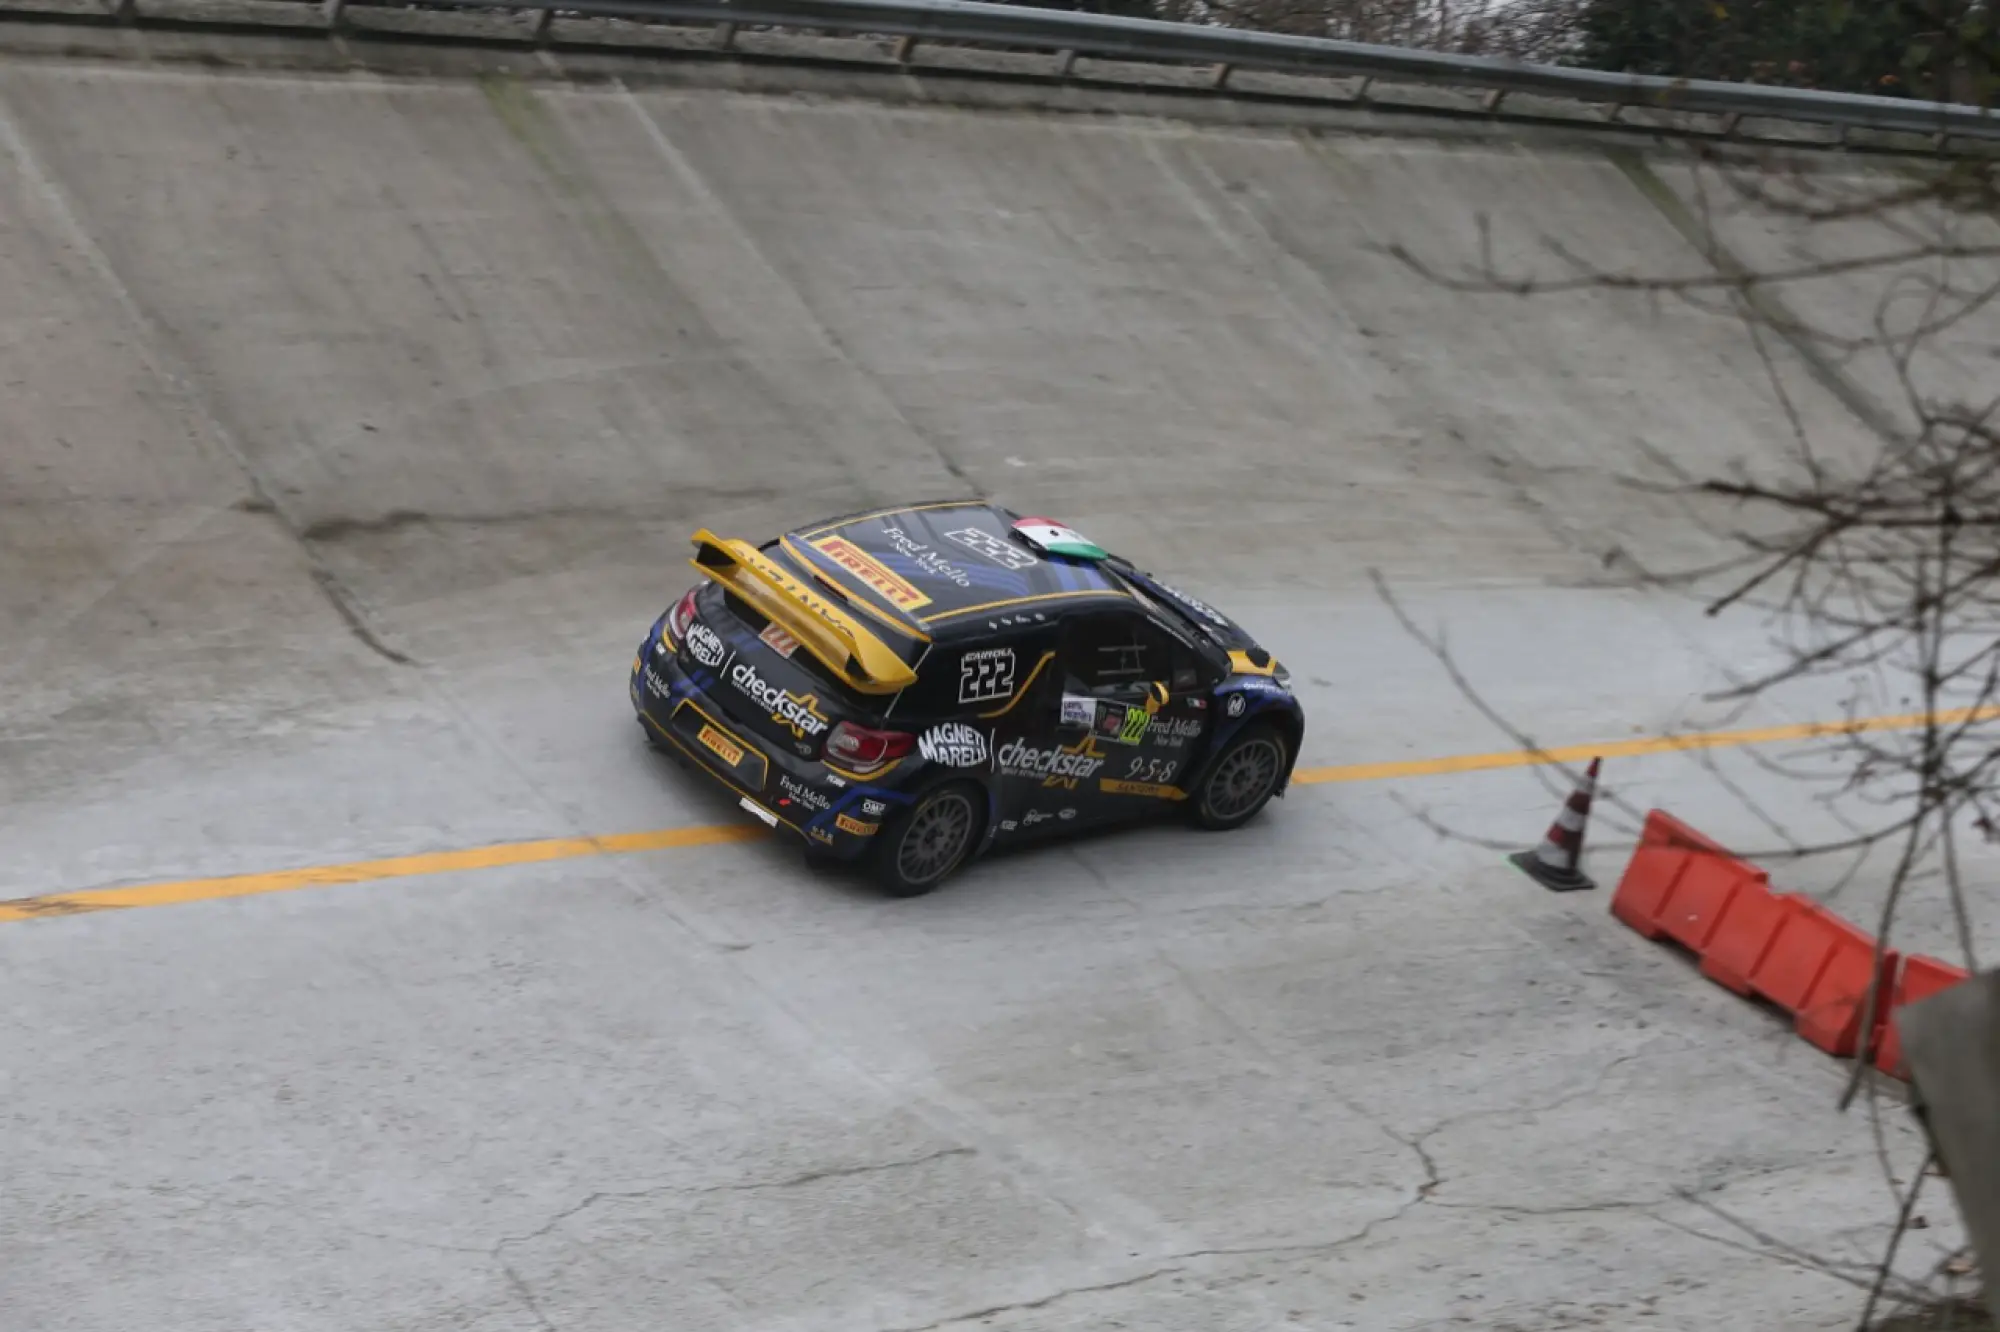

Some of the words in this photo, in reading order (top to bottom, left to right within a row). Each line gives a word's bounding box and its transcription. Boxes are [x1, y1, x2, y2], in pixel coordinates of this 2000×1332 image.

[819, 540, 920, 604] PIRELLI
[958, 652, 1016, 704] 222
[732, 664, 829, 736] checkstar
[918, 722, 985, 750] MAGNETI
[918, 742, 987, 768] MARELLI
[998, 736, 1105, 778] checkstar
[780, 775, 802, 795] Fred
[800, 786, 831, 811] Mello
